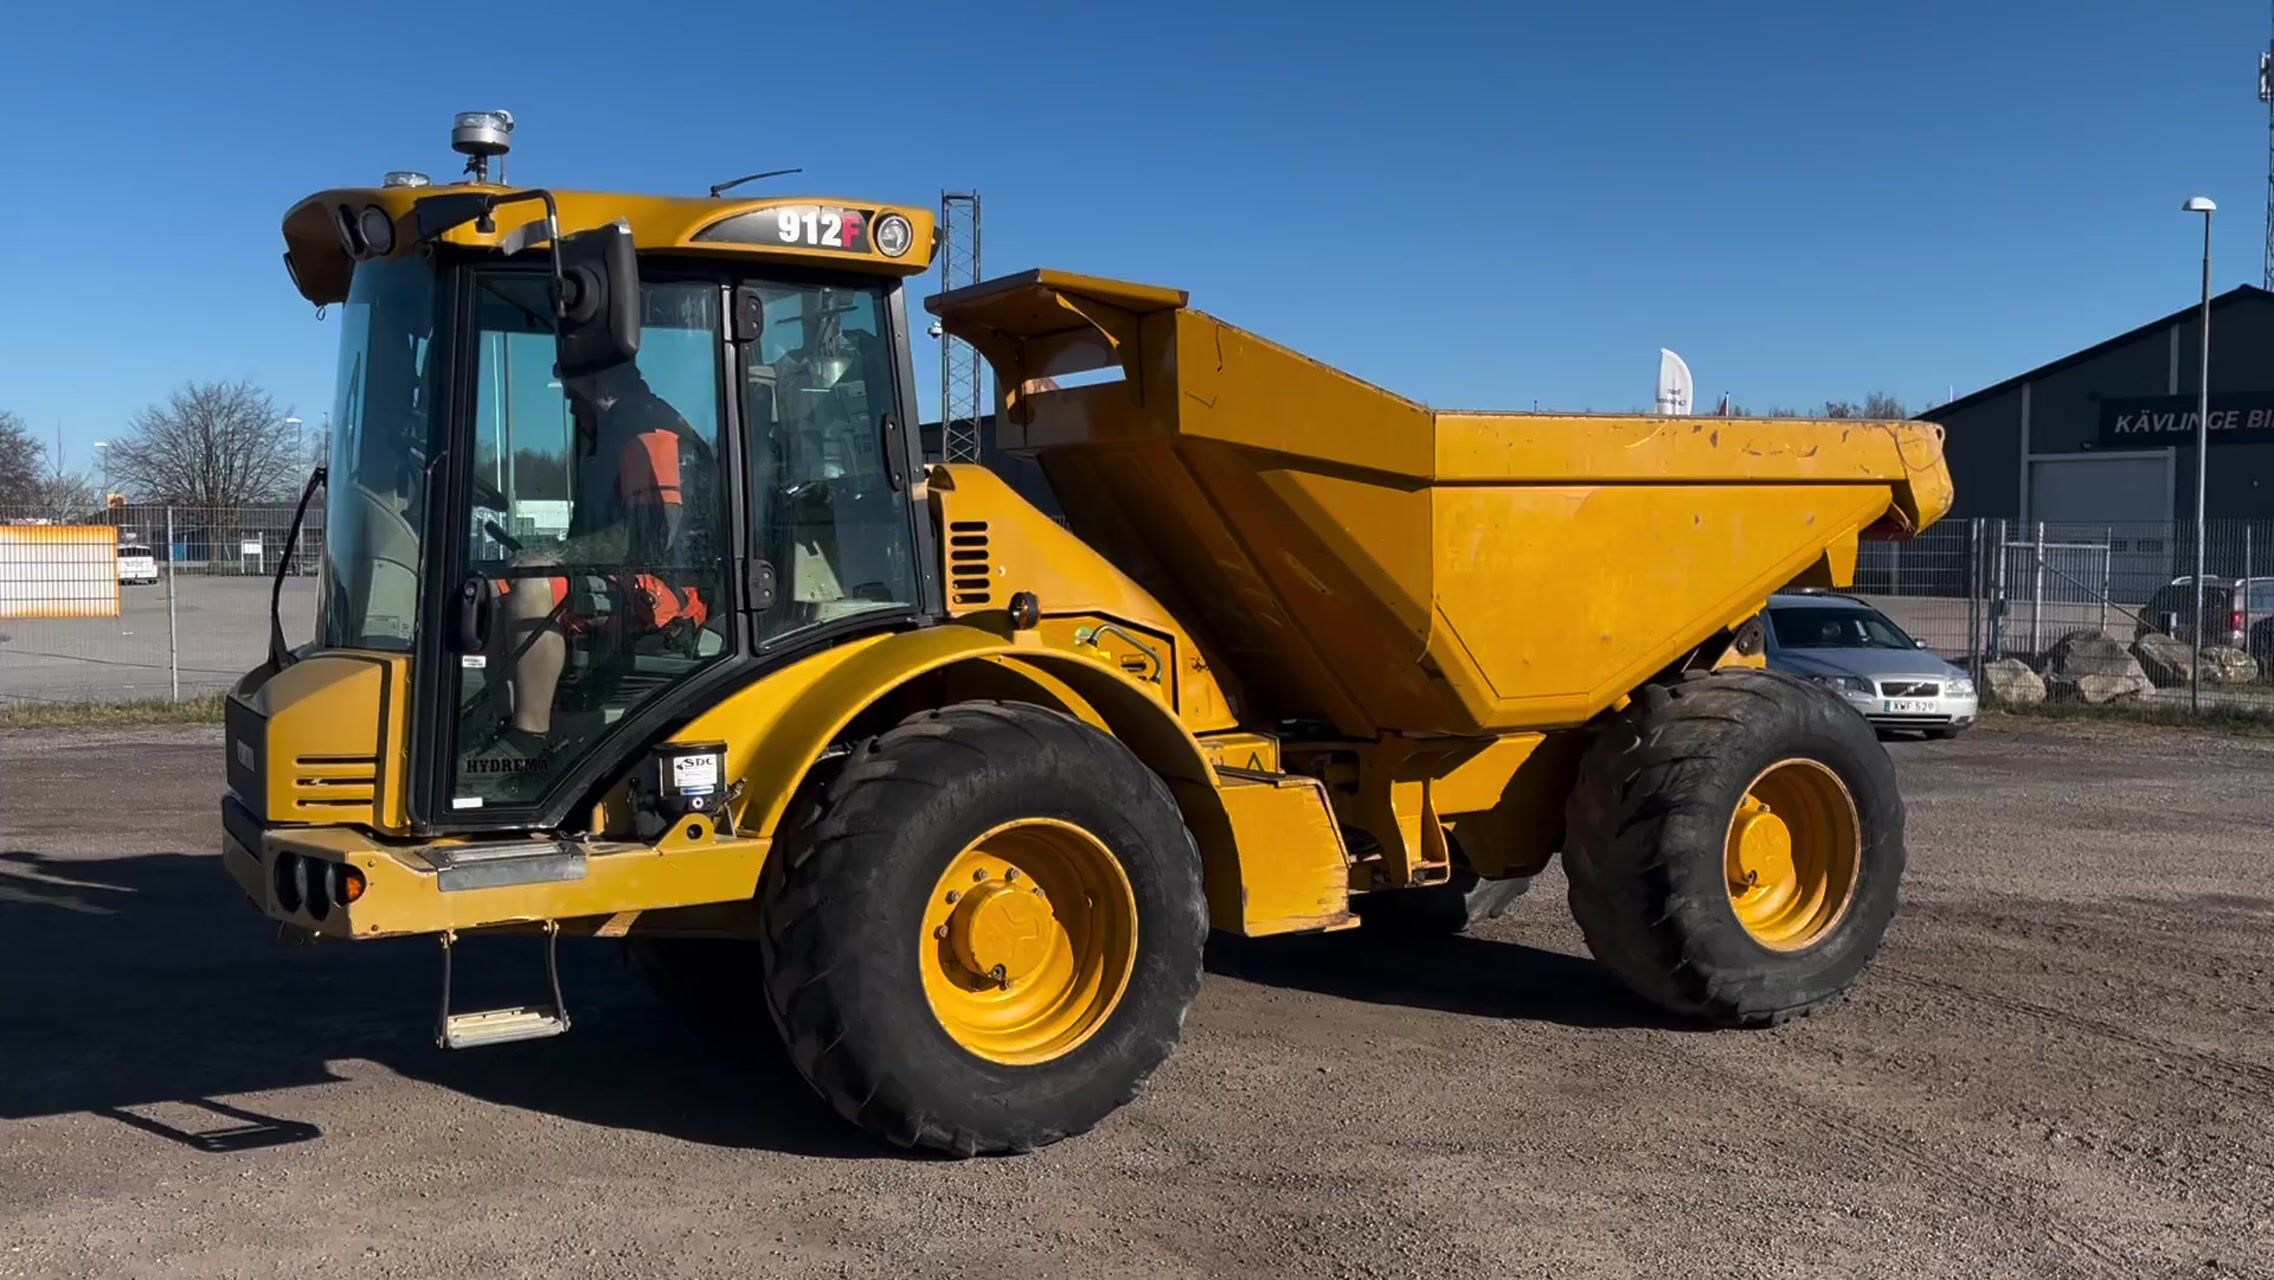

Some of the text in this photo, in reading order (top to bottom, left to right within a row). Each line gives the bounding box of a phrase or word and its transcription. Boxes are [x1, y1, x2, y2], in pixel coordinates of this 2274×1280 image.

[778, 211, 860, 248] 912F
[2246, 409, 2274, 428] BI
[466, 758, 548, 773] HYDREMA
